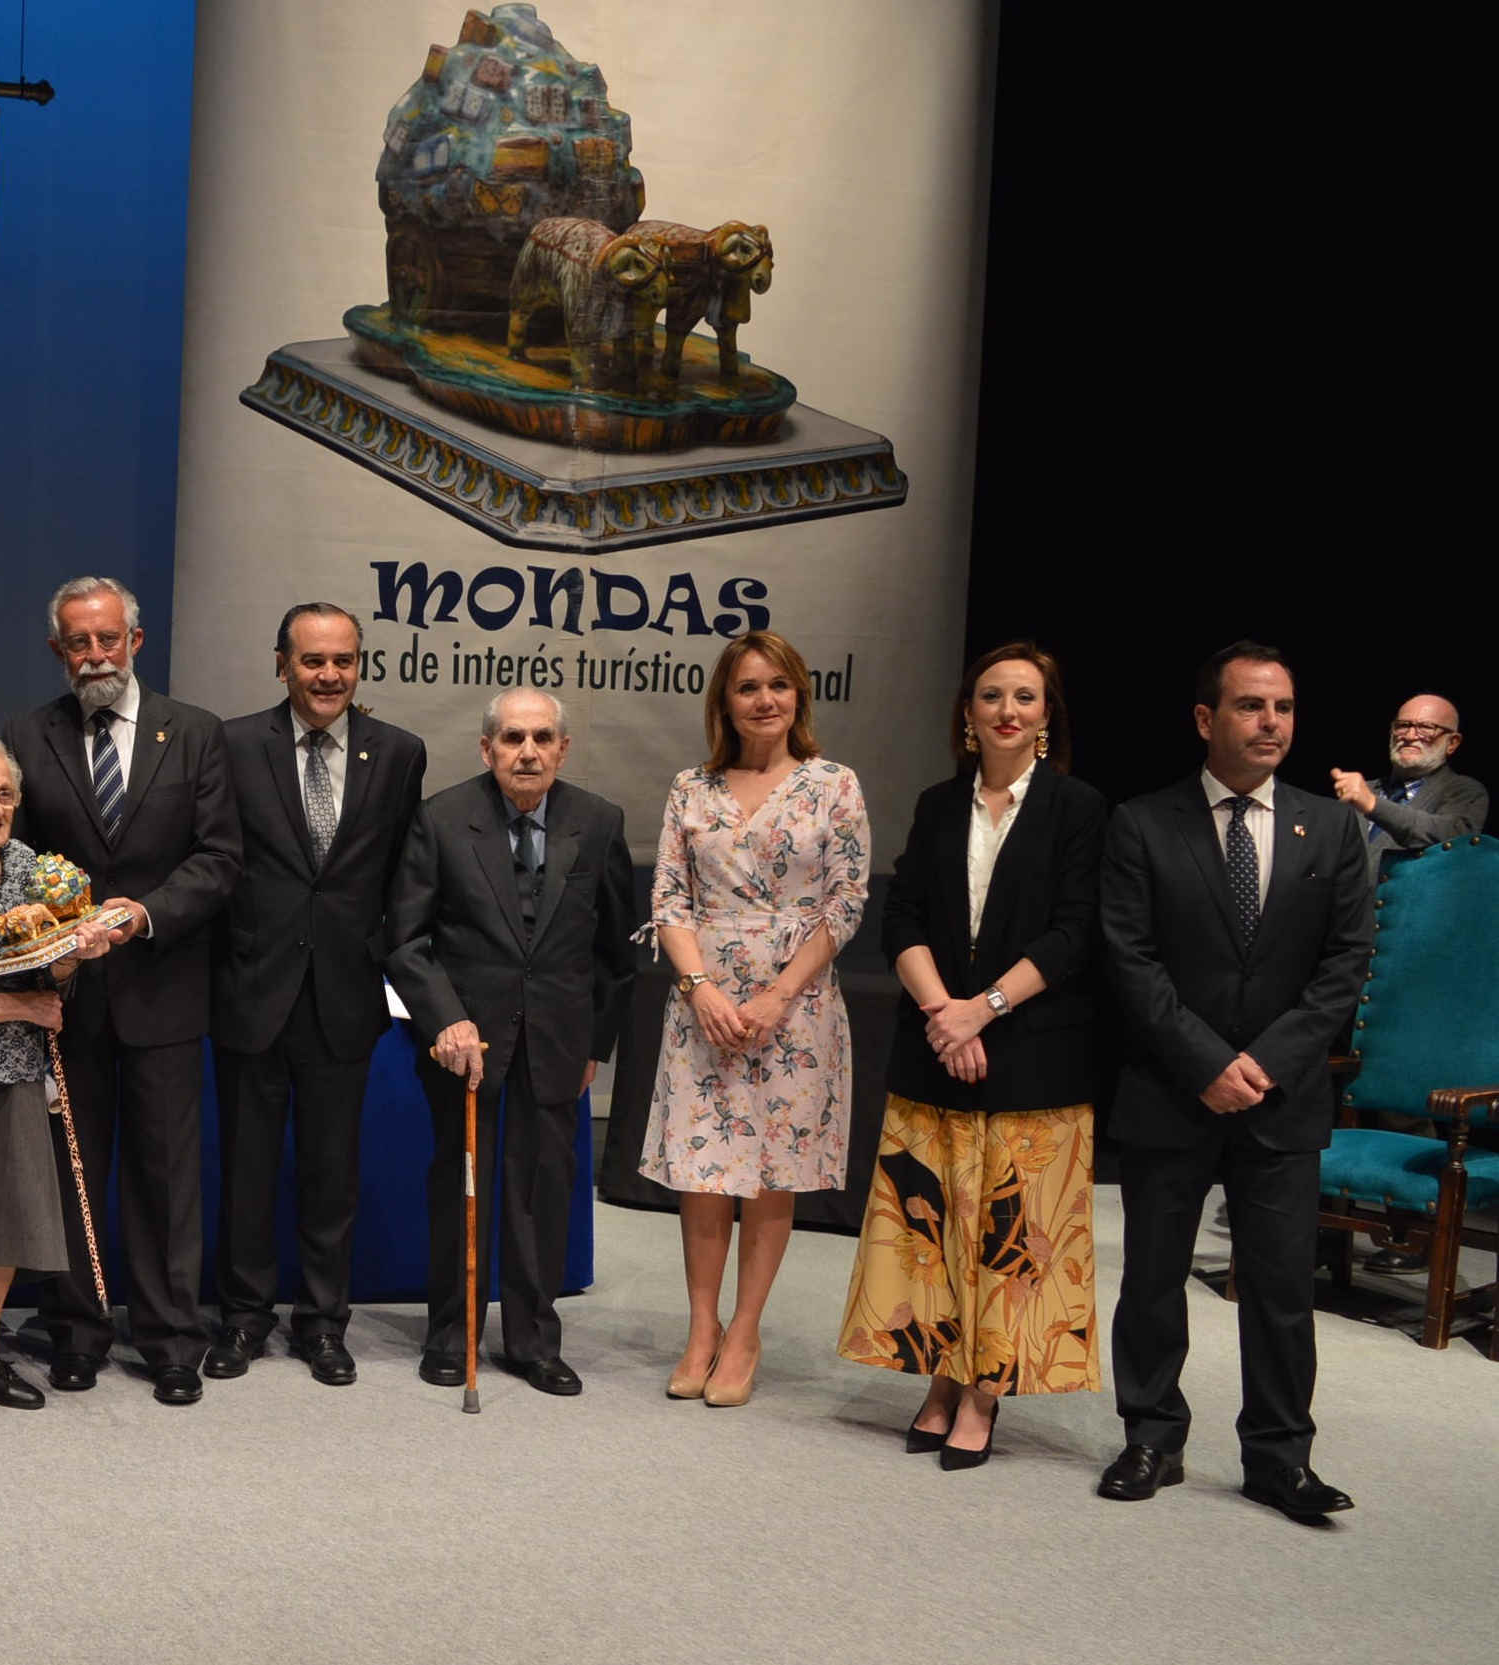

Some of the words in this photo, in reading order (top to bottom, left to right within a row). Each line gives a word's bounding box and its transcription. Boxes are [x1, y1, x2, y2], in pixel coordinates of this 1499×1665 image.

[400, 633, 439, 684] de
[452, 641, 564, 688] interés
[577, 647, 705, 695] turístico
